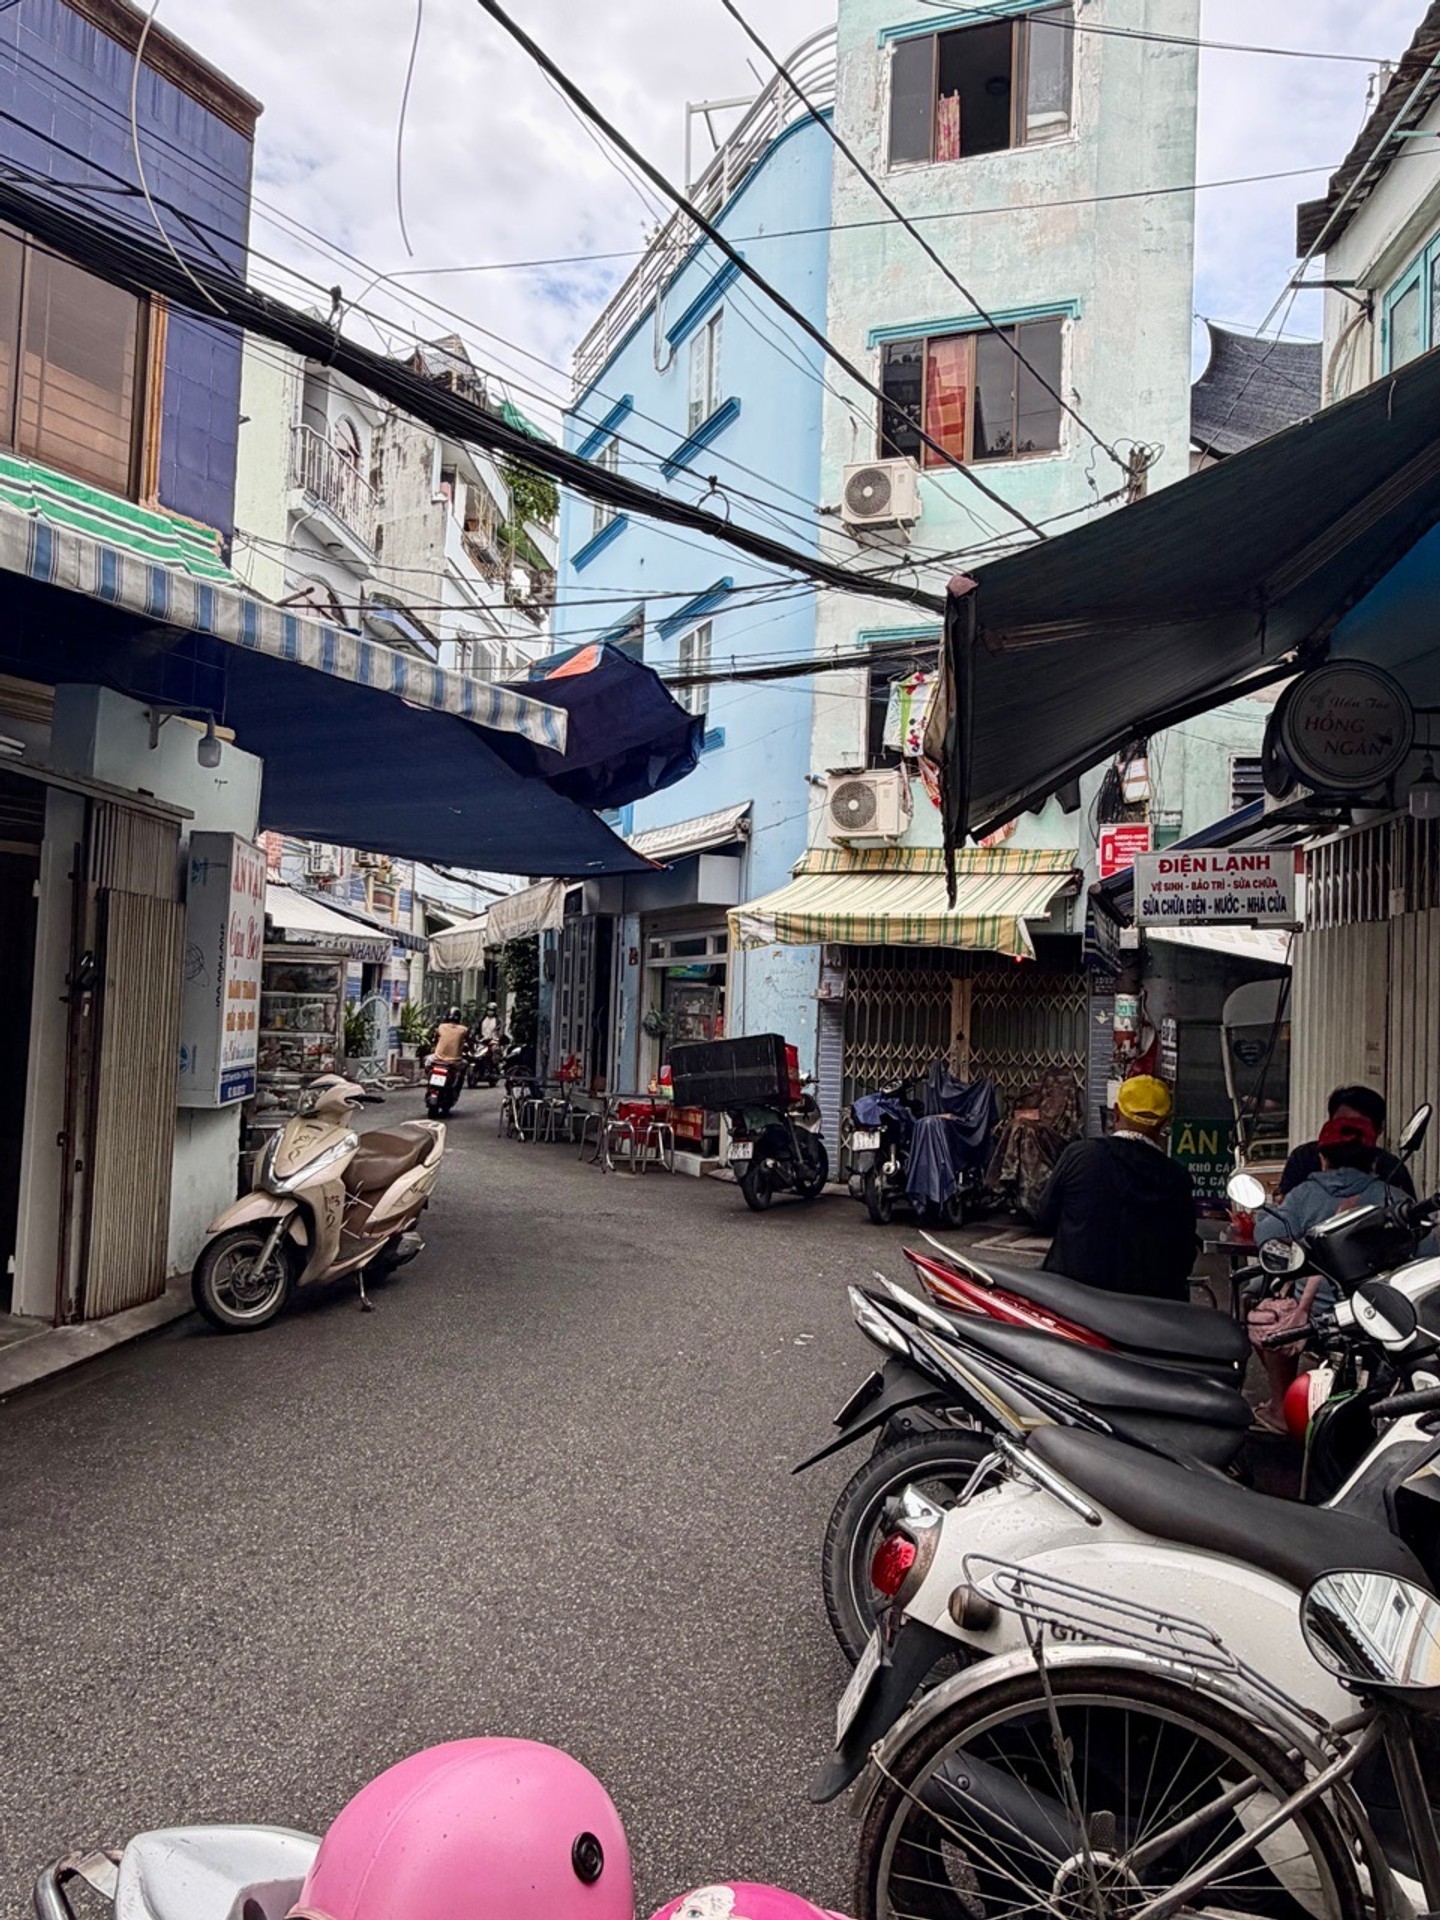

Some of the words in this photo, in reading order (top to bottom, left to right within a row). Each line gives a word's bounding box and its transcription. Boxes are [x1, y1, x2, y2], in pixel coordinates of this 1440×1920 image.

[1158, 854, 1207, 877] ĐIỆN
[1212, 855, 1271, 876] LẠNH
[1151, 881, 1162, 893] VỆ
[1164, 882, 1184, 891] SINH
[1191, 878, 1210, 891] BẢO
[1211, 878, 1225, 890] TRÌ
[1233, 877, 1250, 890] SỬA
[1253, 876, 1278, 889] CHỮA
[1142, 893, 1160, 915] SỬA
[1161, 894, 1185, 915] CHỮA
[1214, 892, 1239, 914] NƯỚC
[1267, 889, 1287, 913] CỬA
[1177, 1122, 1218, 1155] ĂN
